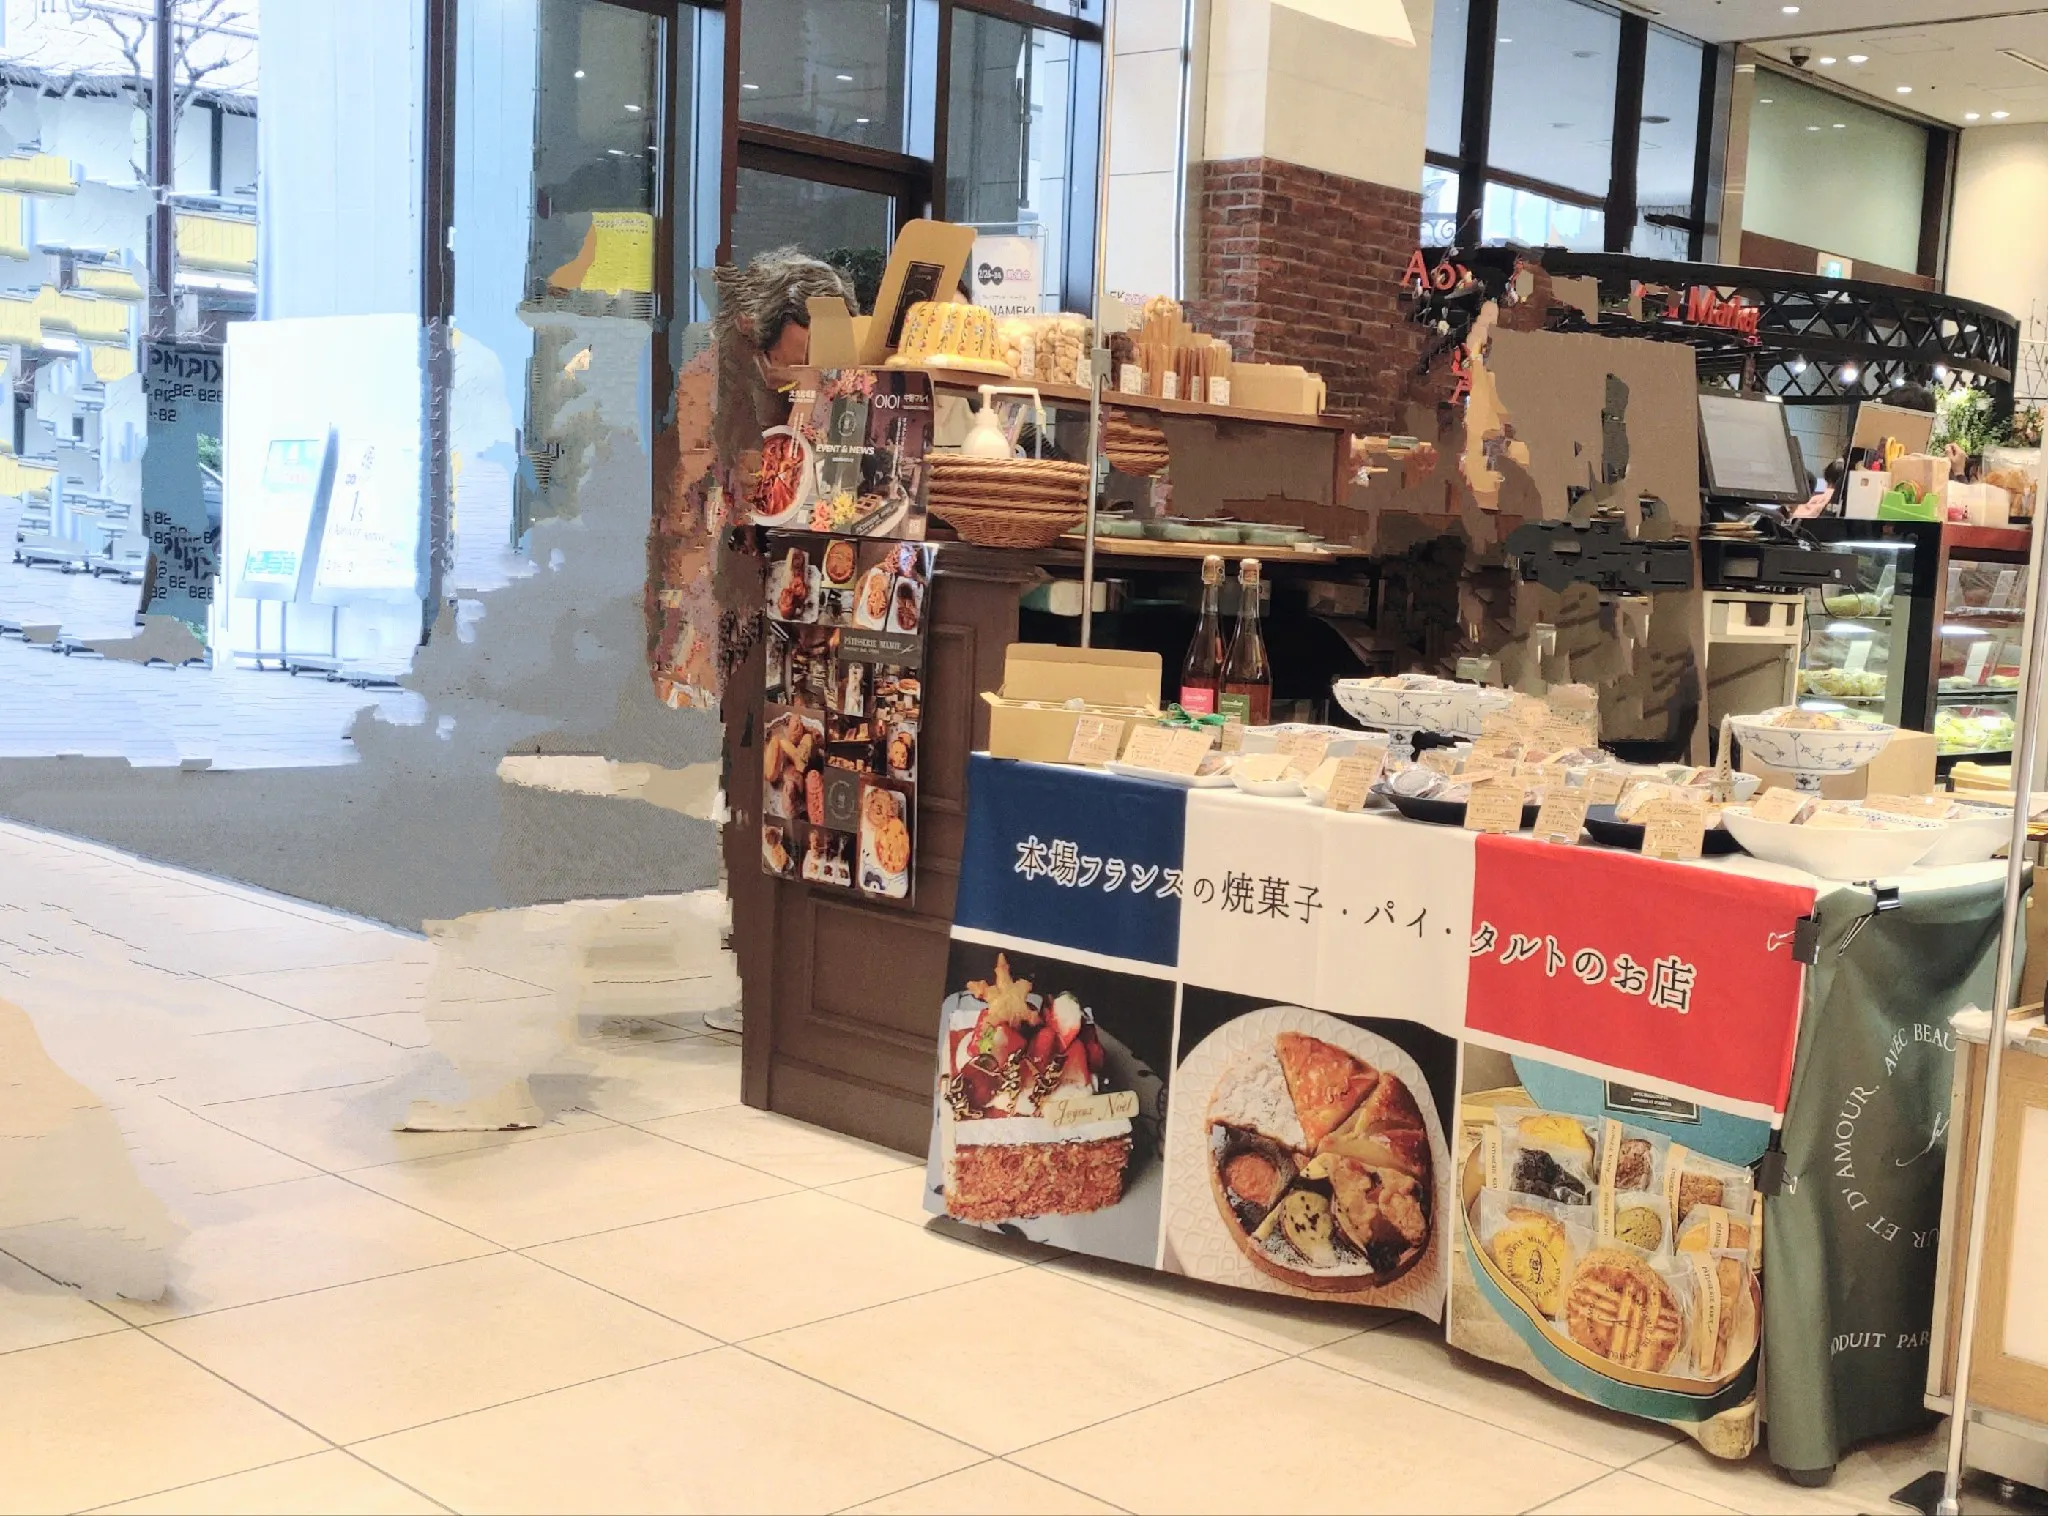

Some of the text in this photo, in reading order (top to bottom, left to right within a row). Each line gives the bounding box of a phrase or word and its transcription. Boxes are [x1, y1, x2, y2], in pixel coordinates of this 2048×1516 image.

[816, 444, 875, 456] EVENT & NEWS
[1884, 1028, 1908, 1077] AVEC
[1866, 1216, 1902, 1242] ET
